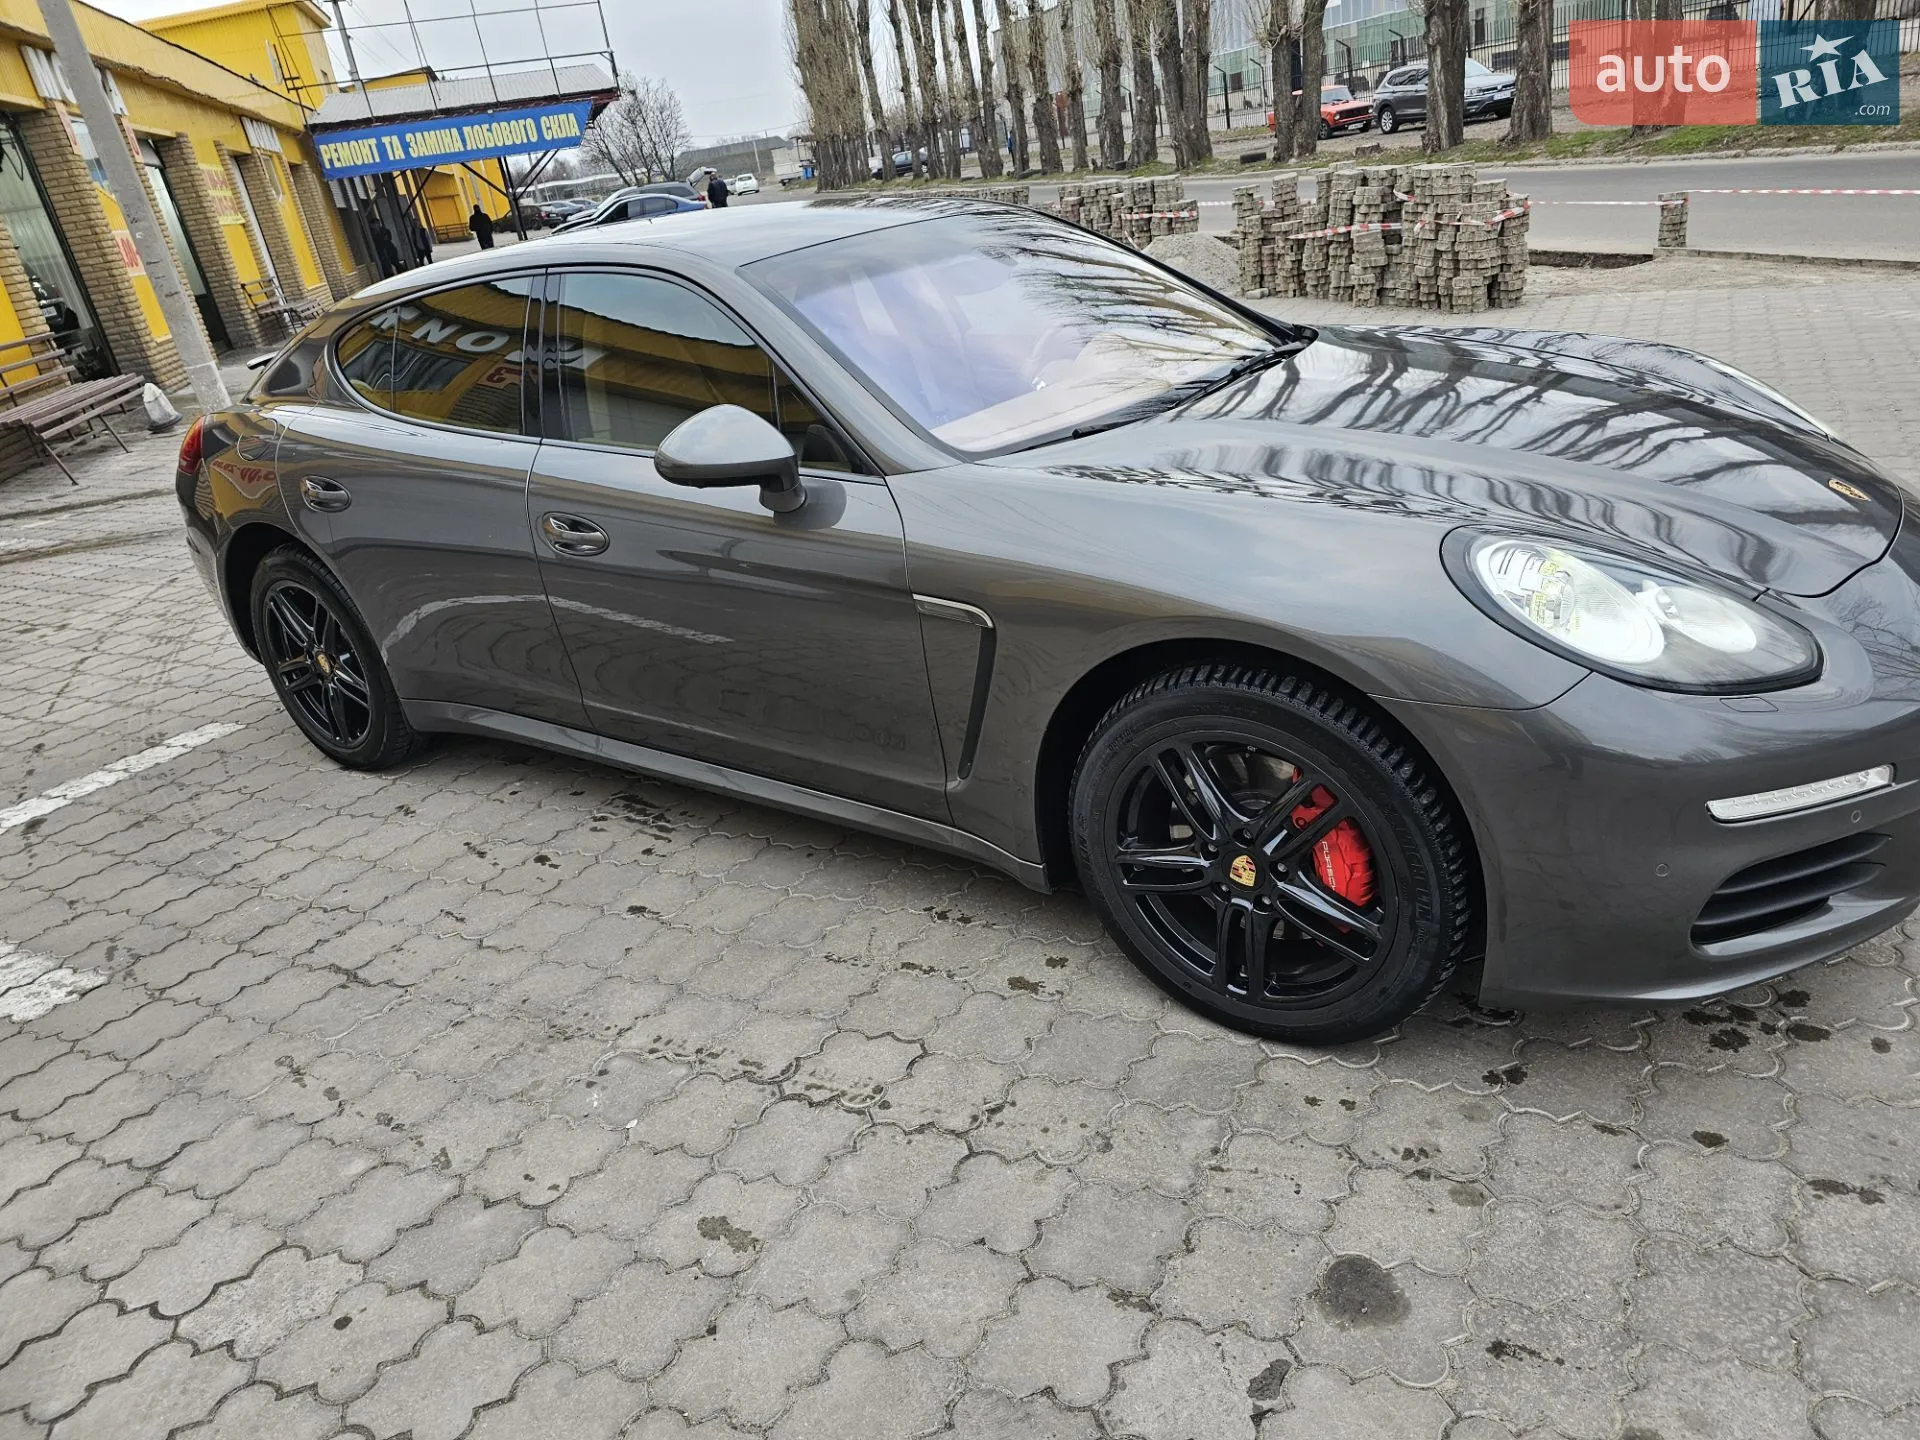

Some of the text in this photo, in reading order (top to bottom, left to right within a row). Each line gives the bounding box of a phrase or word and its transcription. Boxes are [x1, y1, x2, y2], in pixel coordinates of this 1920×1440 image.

[320, 112, 580, 169] РЕМОНТ ТА ЗАМІНА ЛОБОВОГО СКЛА
